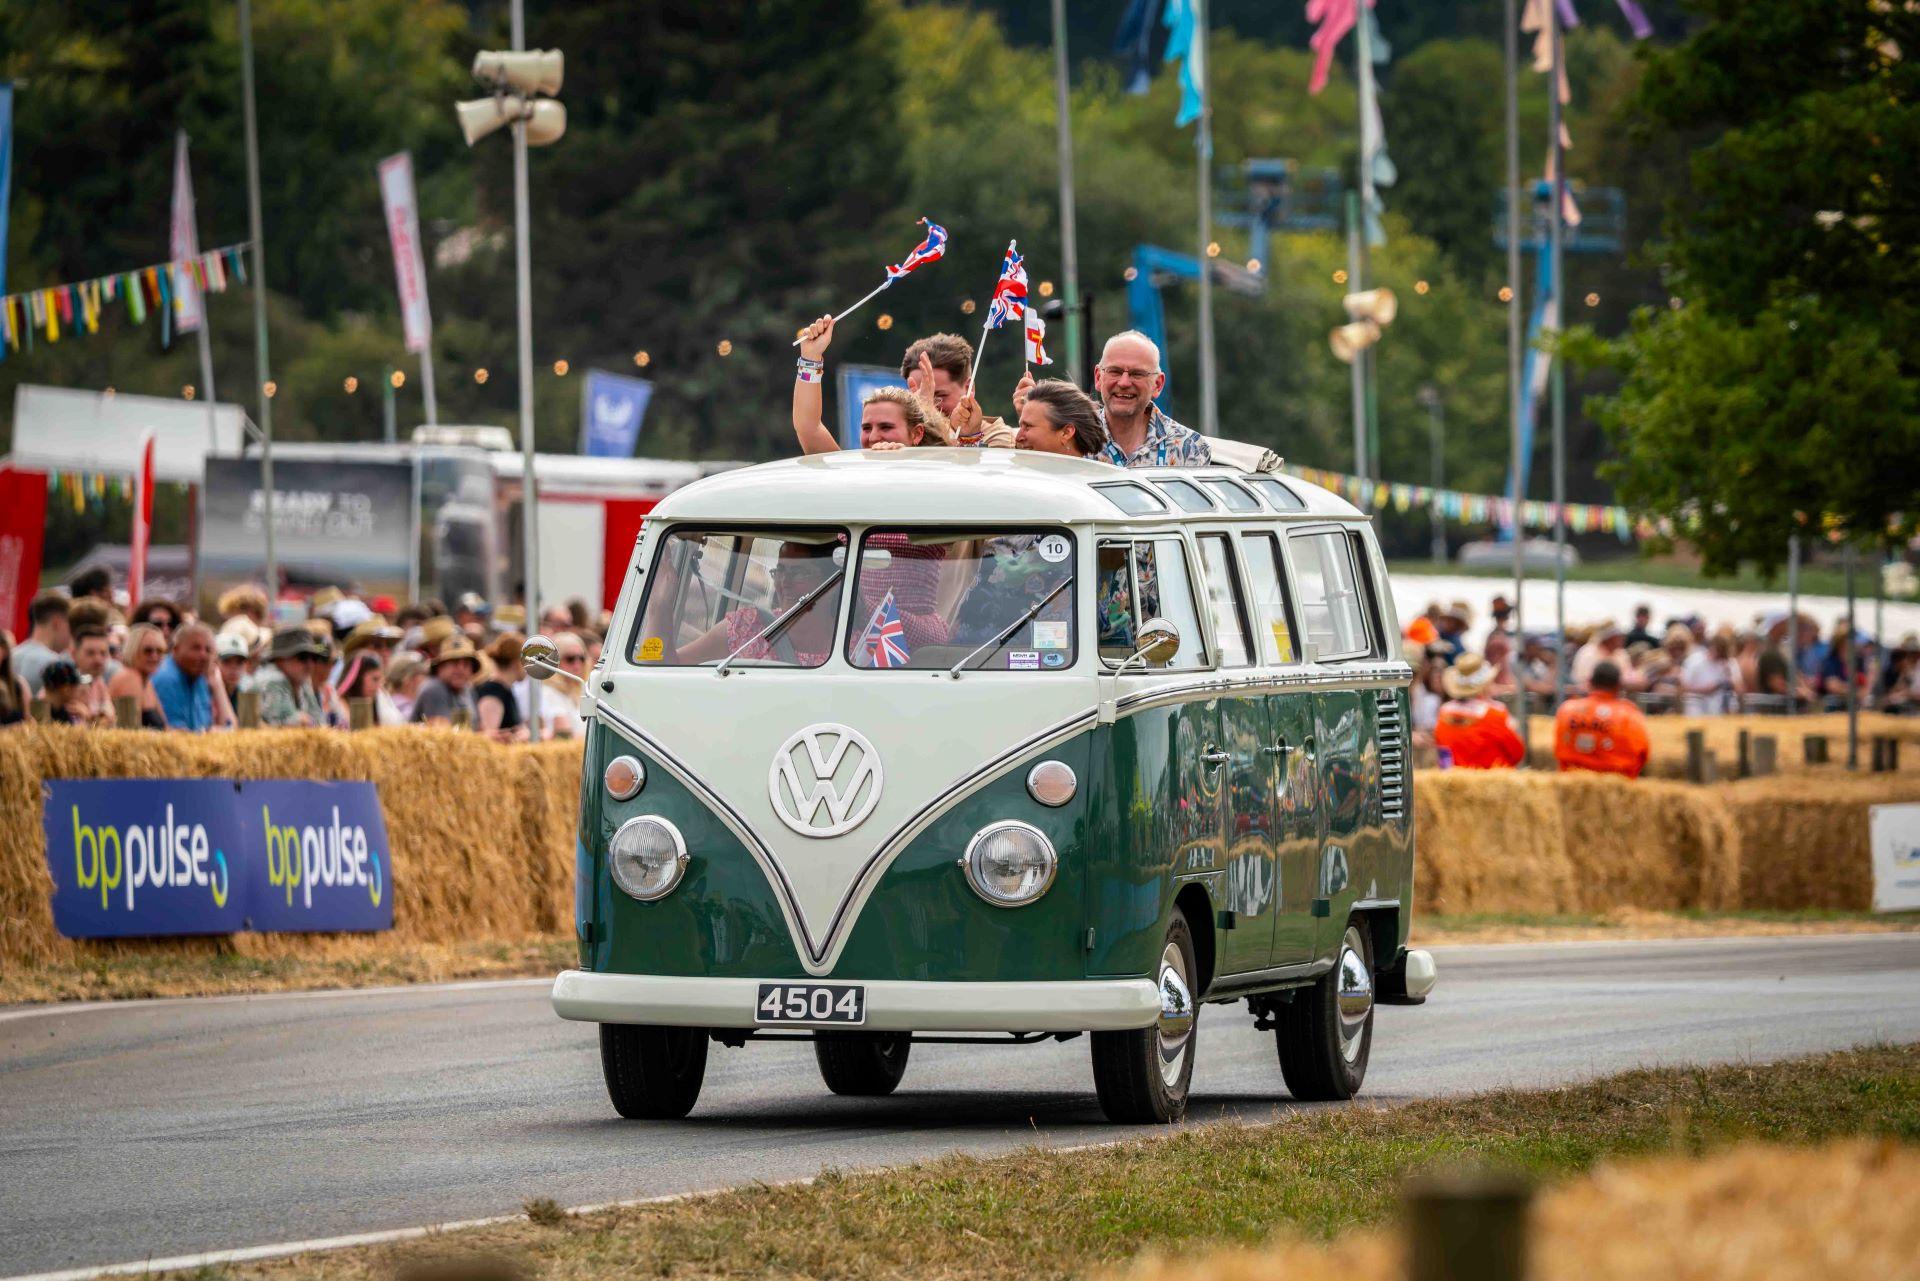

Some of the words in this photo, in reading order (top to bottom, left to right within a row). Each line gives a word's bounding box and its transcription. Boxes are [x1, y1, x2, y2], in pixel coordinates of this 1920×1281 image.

[1046, 543, 1063, 554] 10
[771, 725, 881, 836] VW
[72, 804, 122, 911] bp
[125, 803, 210, 912] pulse
[262, 804, 302, 908] bp
[302, 804, 369, 909] pulse
[760, 987, 858, 1020] 4504
